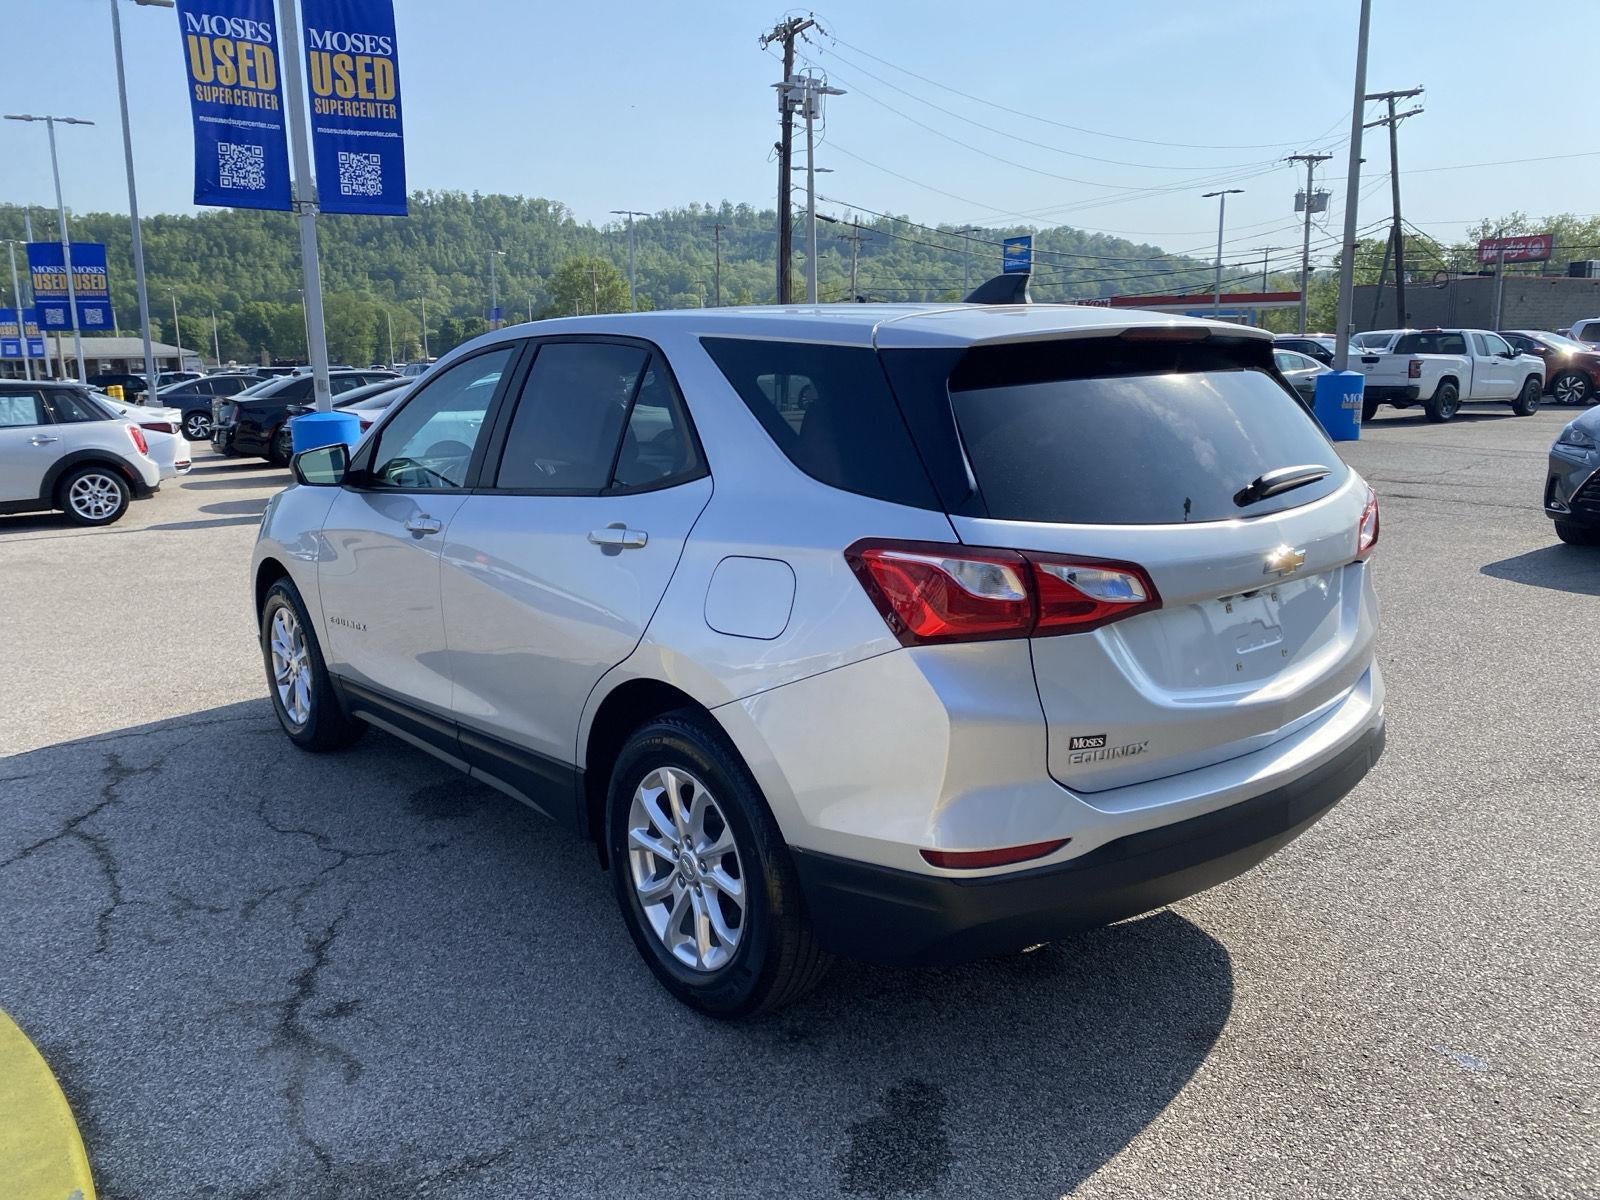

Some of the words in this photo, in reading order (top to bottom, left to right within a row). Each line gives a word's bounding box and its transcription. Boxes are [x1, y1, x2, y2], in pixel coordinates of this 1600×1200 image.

[184, 12, 272, 43] MOSES
[308, 28, 392, 55] MOSES
[187, 35, 277, 90] USED
[310, 51, 396, 100] USED
[195, 85, 279, 111] SUPERCENTER
[314, 98, 397, 119] SUPERCENTER
[199, 115, 281, 131] mosesusedsupercenter.com
[316, 126, 398, 138] mosesusedsupercenter.com
[72, 266, 106, 274] MOSES
[32, 274, 68, 290] USED
[72, 274, 107, 290] USED
[1069, 740, 1150, 765] EQUINOX
[1072, 737, 1104, 749] MOSES
